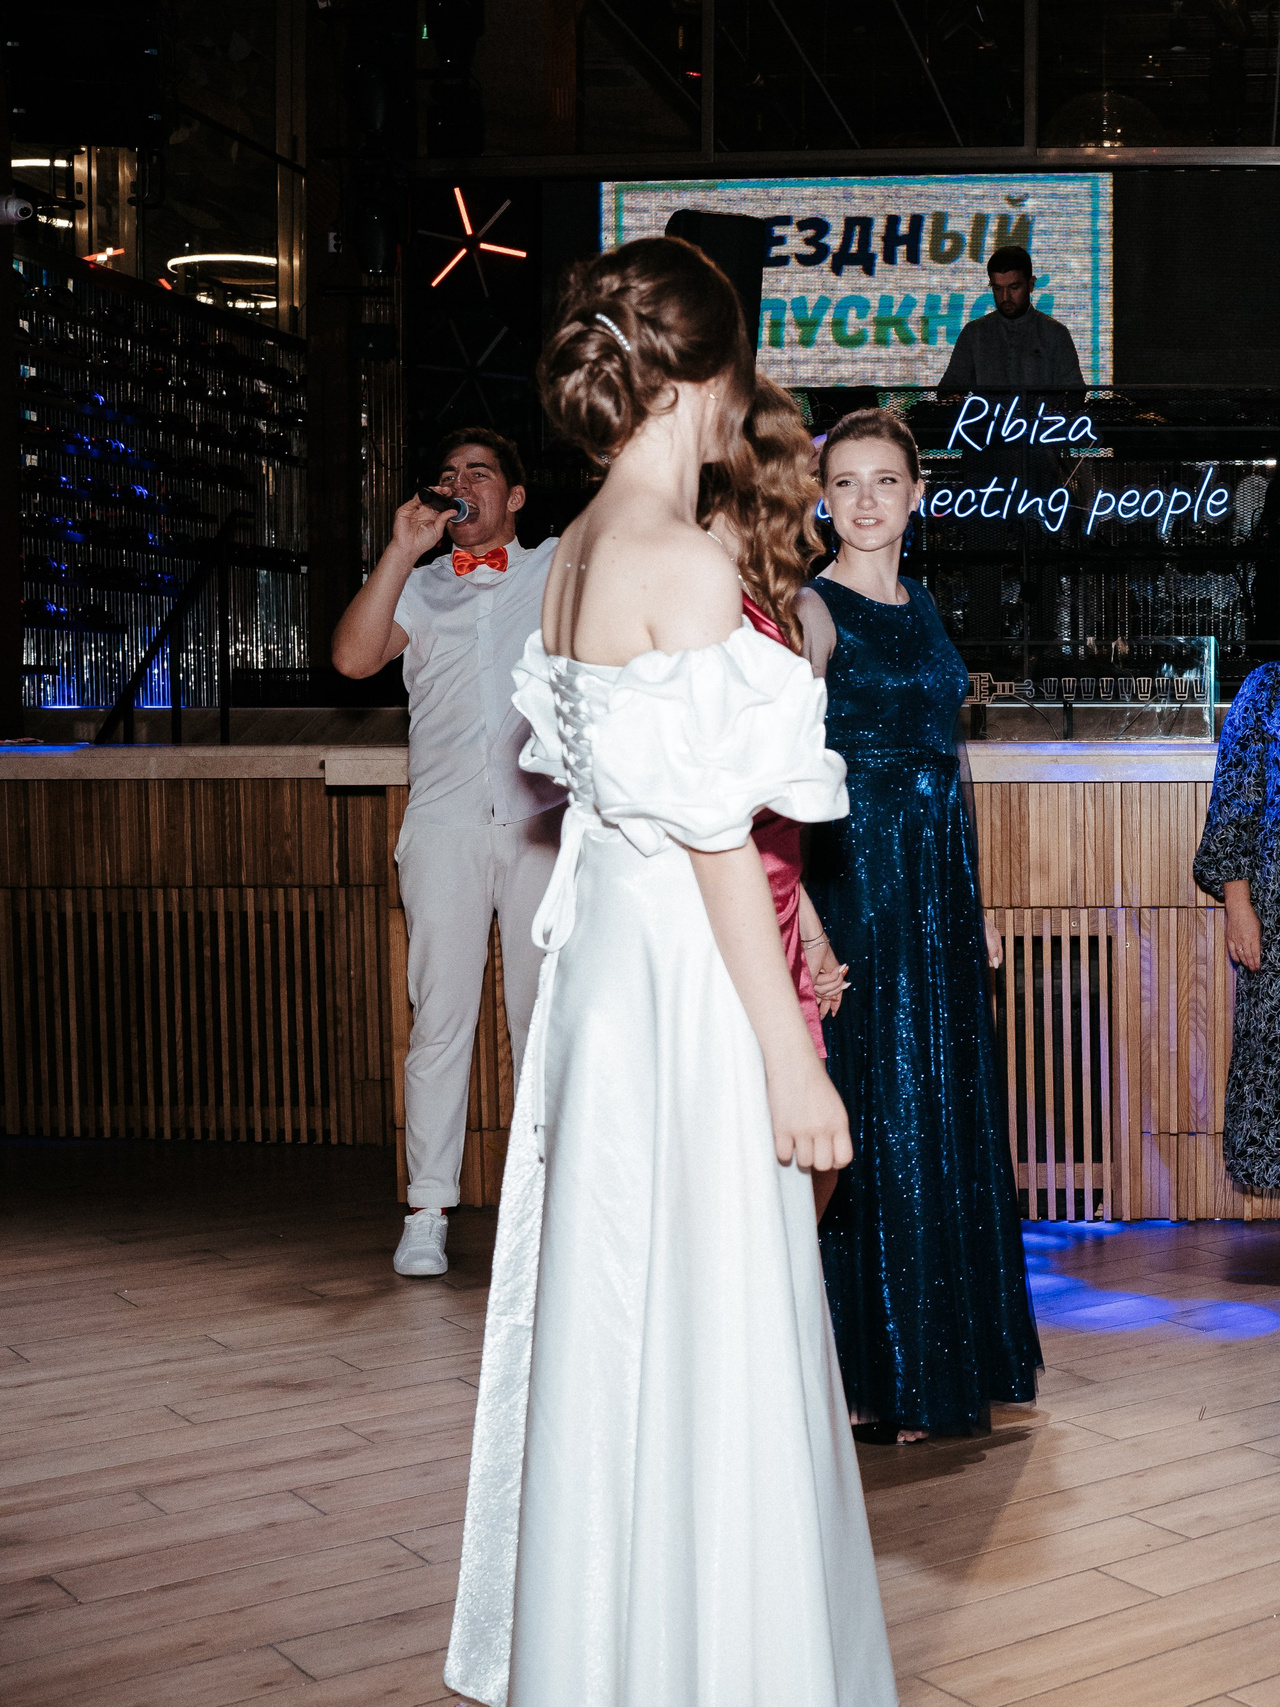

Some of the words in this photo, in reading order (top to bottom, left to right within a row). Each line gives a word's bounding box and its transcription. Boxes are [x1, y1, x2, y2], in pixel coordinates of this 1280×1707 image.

[763, 193, 1034, 276] ЕЗДНЫЙ
[947, 395, 1099, 452] Ribiza
[1086, 466, 1229, 536] people
